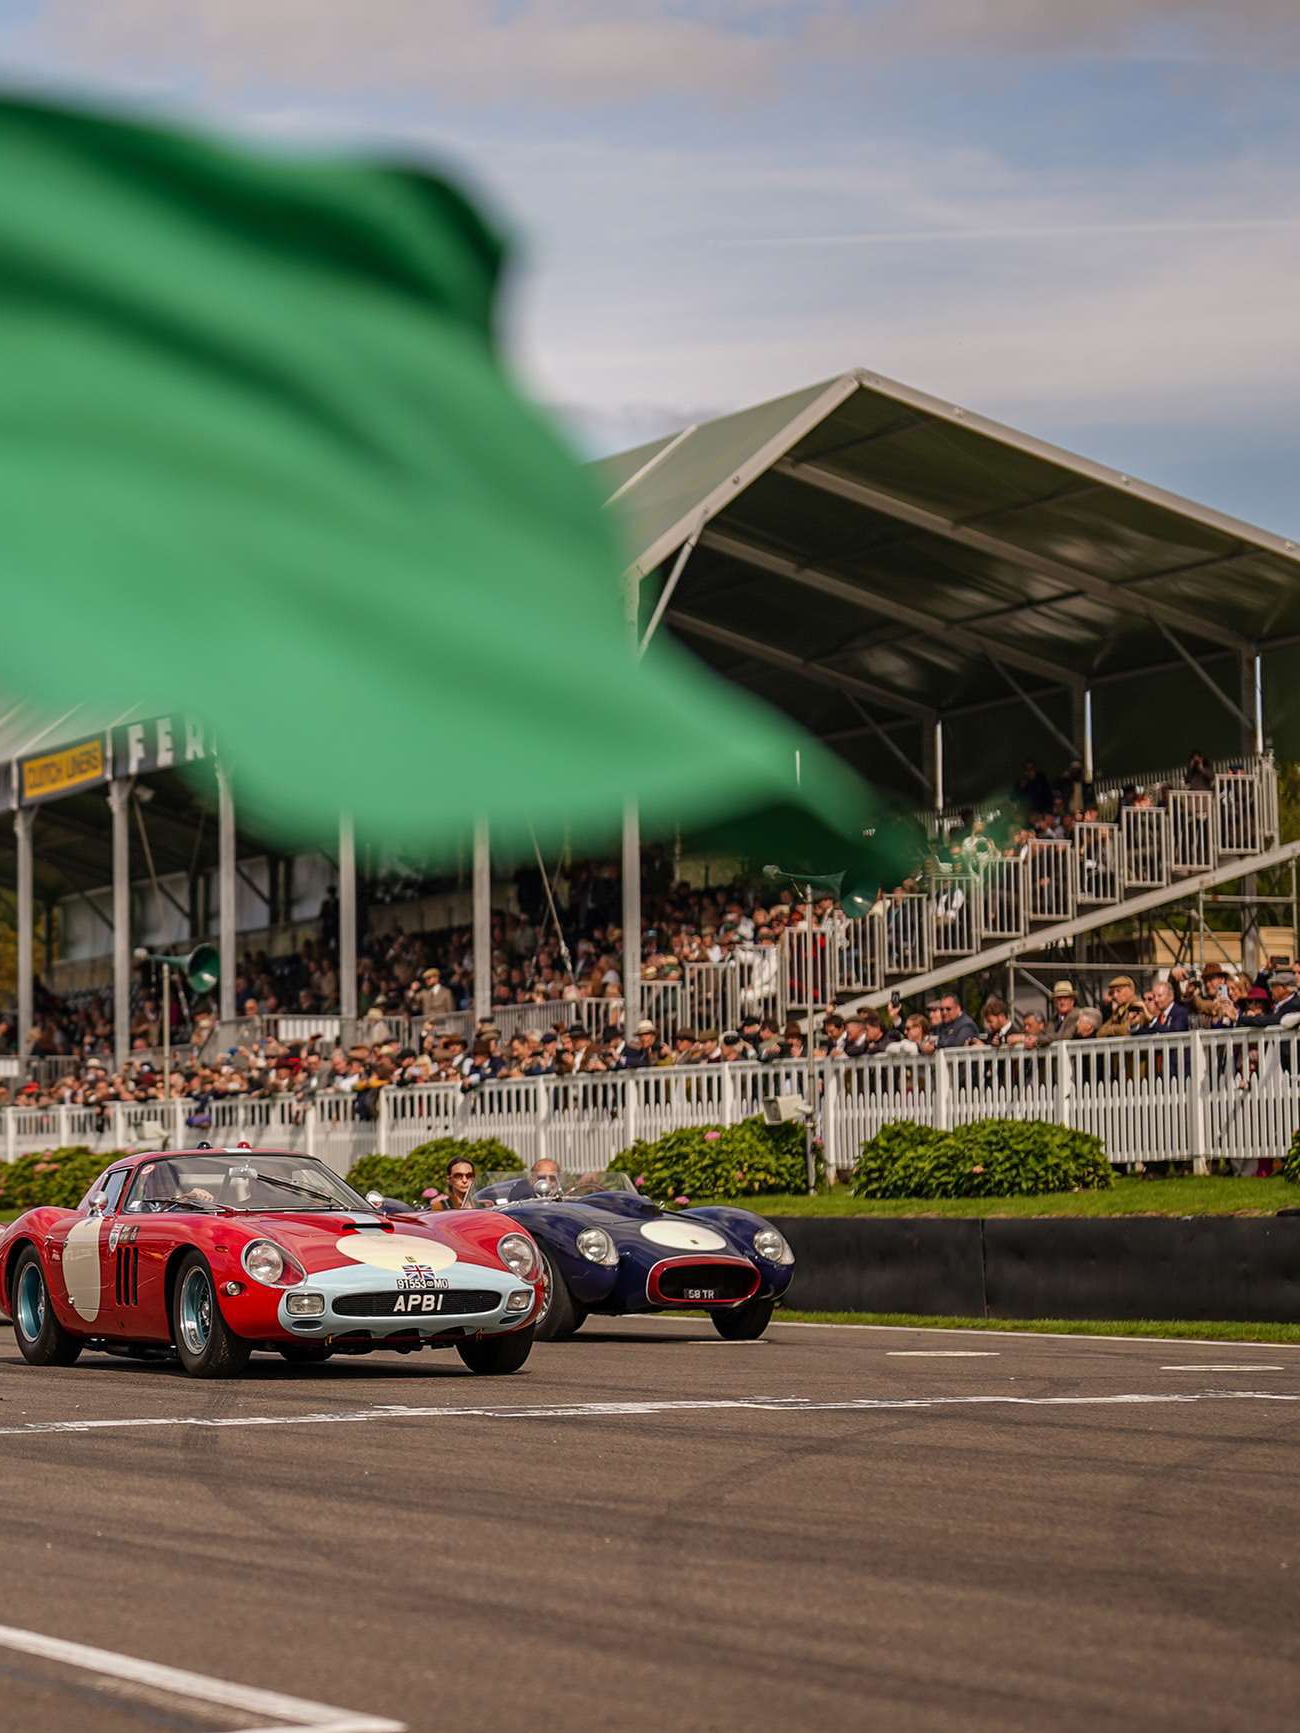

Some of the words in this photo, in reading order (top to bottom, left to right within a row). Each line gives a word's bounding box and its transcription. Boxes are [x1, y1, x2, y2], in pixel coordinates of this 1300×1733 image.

[128, 717, 205, 774] FER
[397, 1279, 427, 1290] 91553
[434, 1279, 449, 1290] MO
[689, 1289, 701, 1299] 58
[702, 1289, 715, 1299] TR
